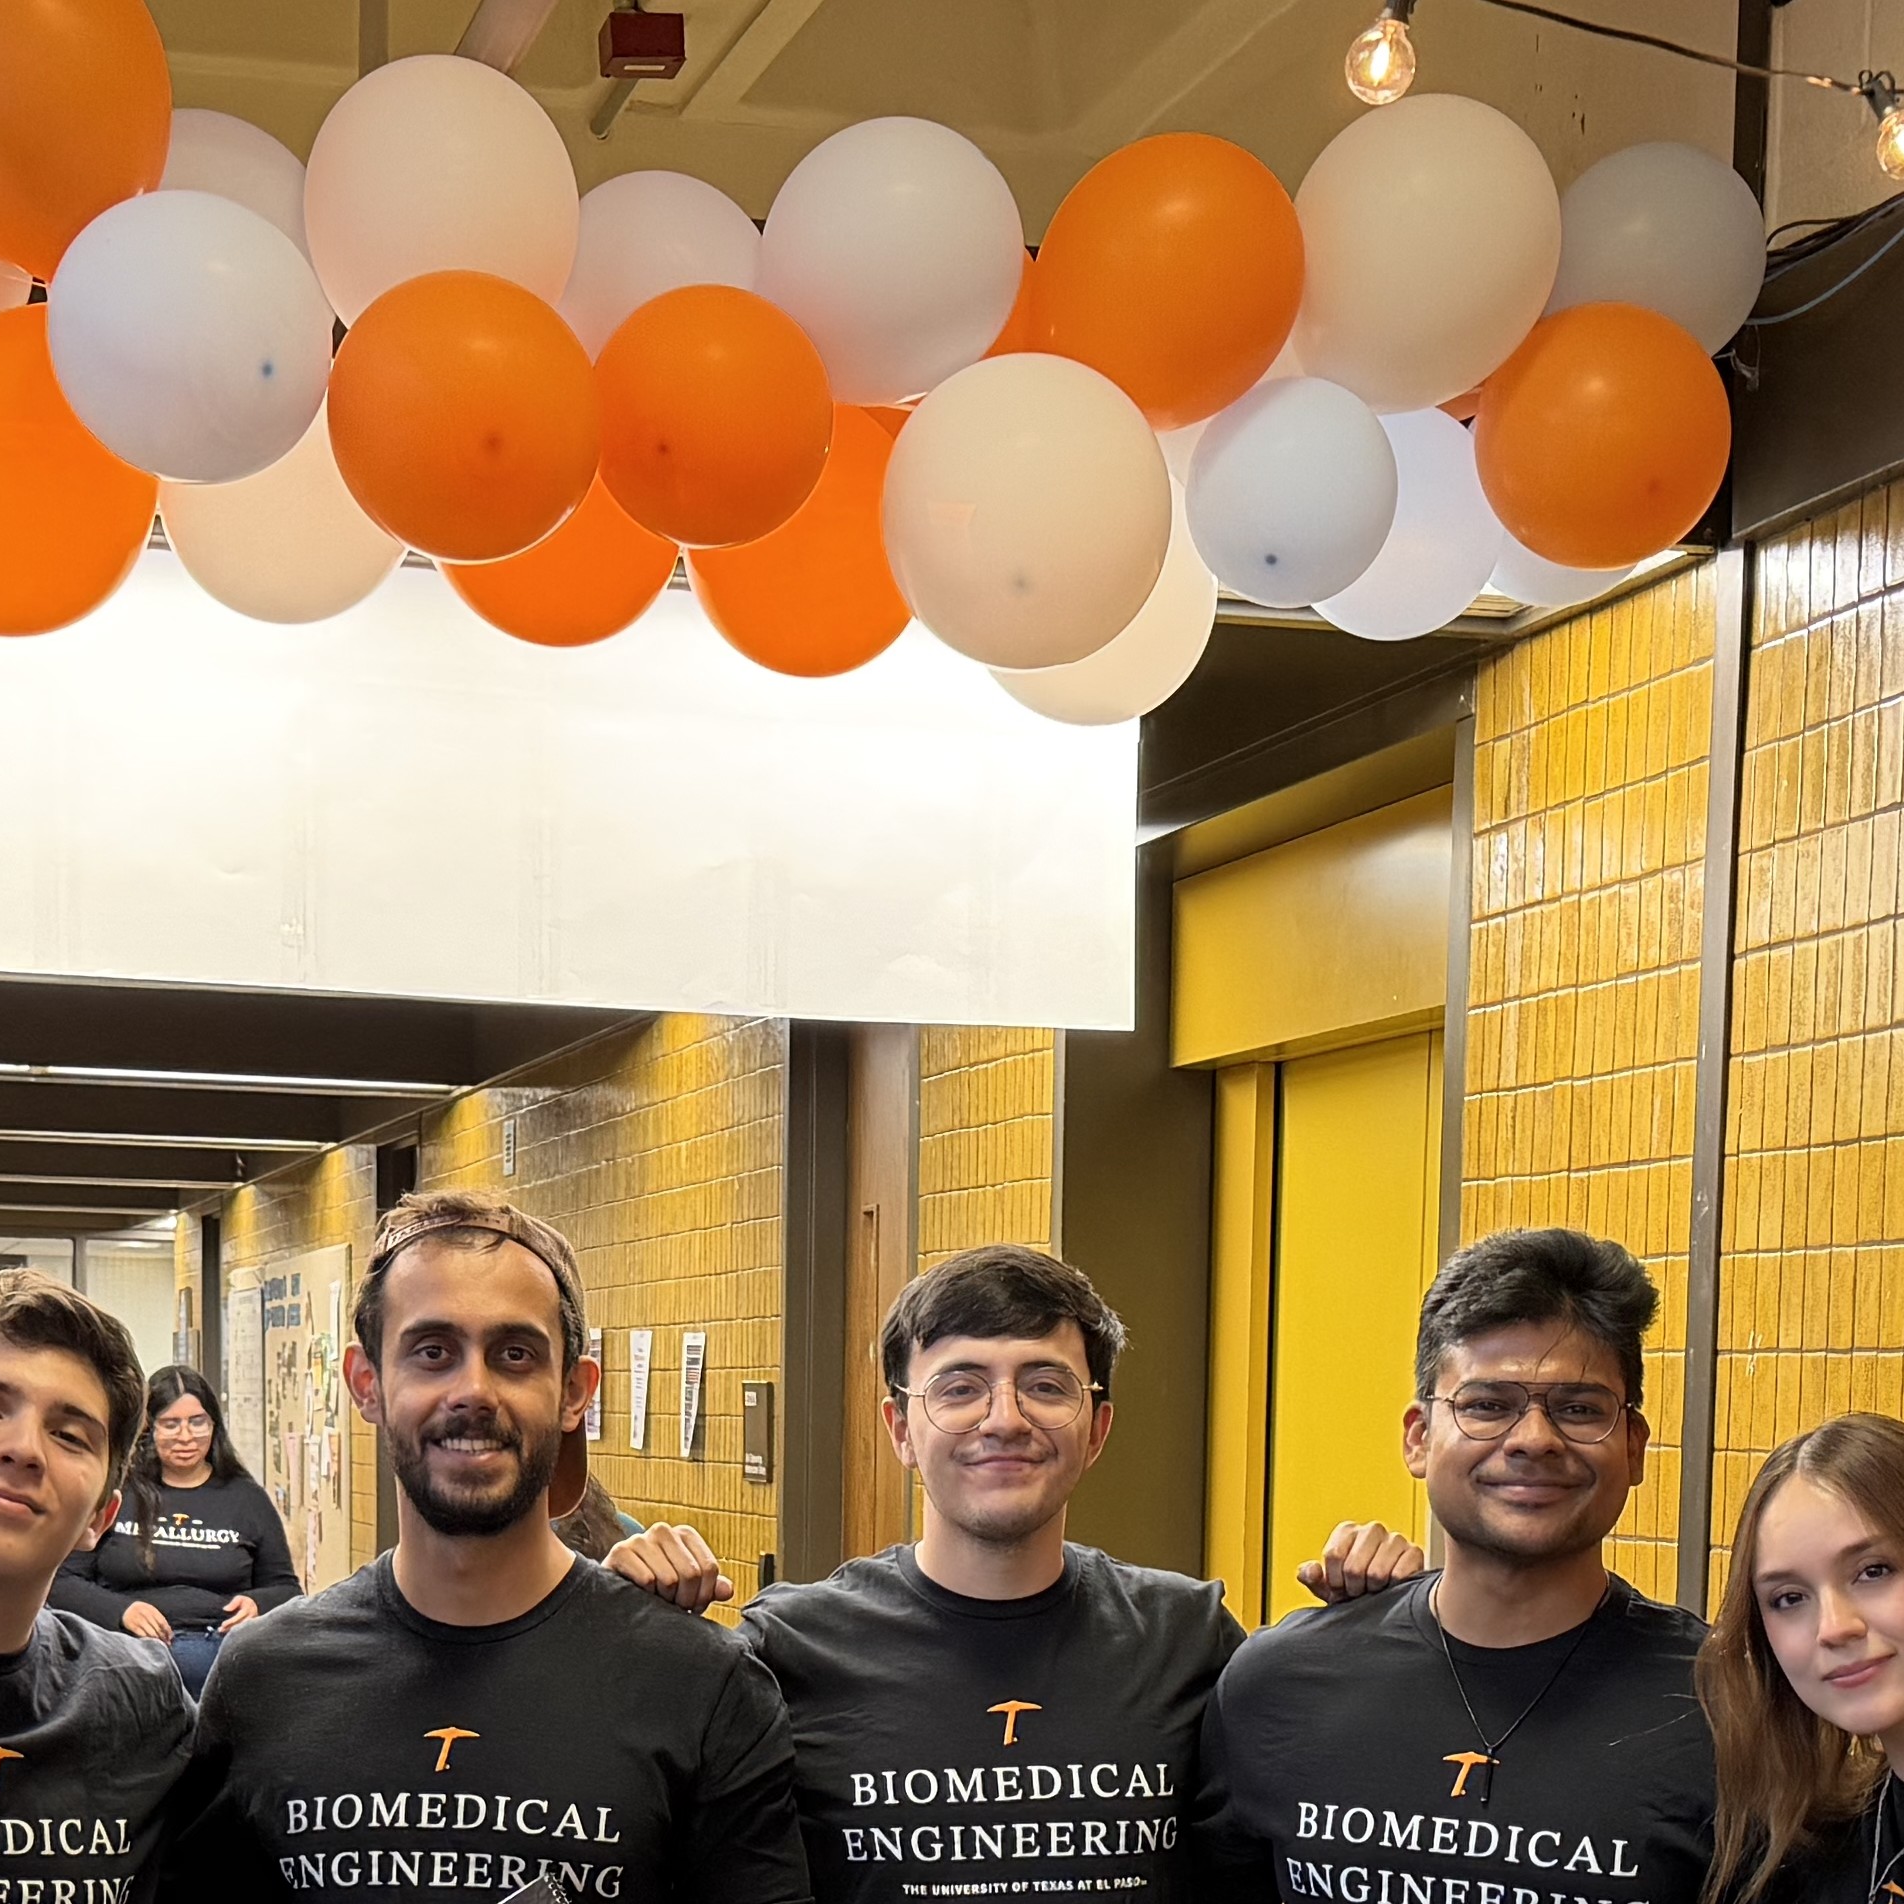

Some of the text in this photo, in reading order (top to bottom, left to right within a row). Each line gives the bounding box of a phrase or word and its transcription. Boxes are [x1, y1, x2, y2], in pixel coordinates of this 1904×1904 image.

[114, 1519, 239, 1544] MALLURGY
[850, 1763, 1174, 1806] BIOMEDICAL
[286, 1792, 621, 1844] BIOMEDICAL
[842, 1816, 1177, 1861] ENGINEERING
[1296, 1802, 1639, 1877] BIOMEDICAL
[279, 1851, 624, 1898] ENGINEERING
[902, 1876, 1141, 1896] THE UNIVERSITY OF TEXAS AT EL PASO
